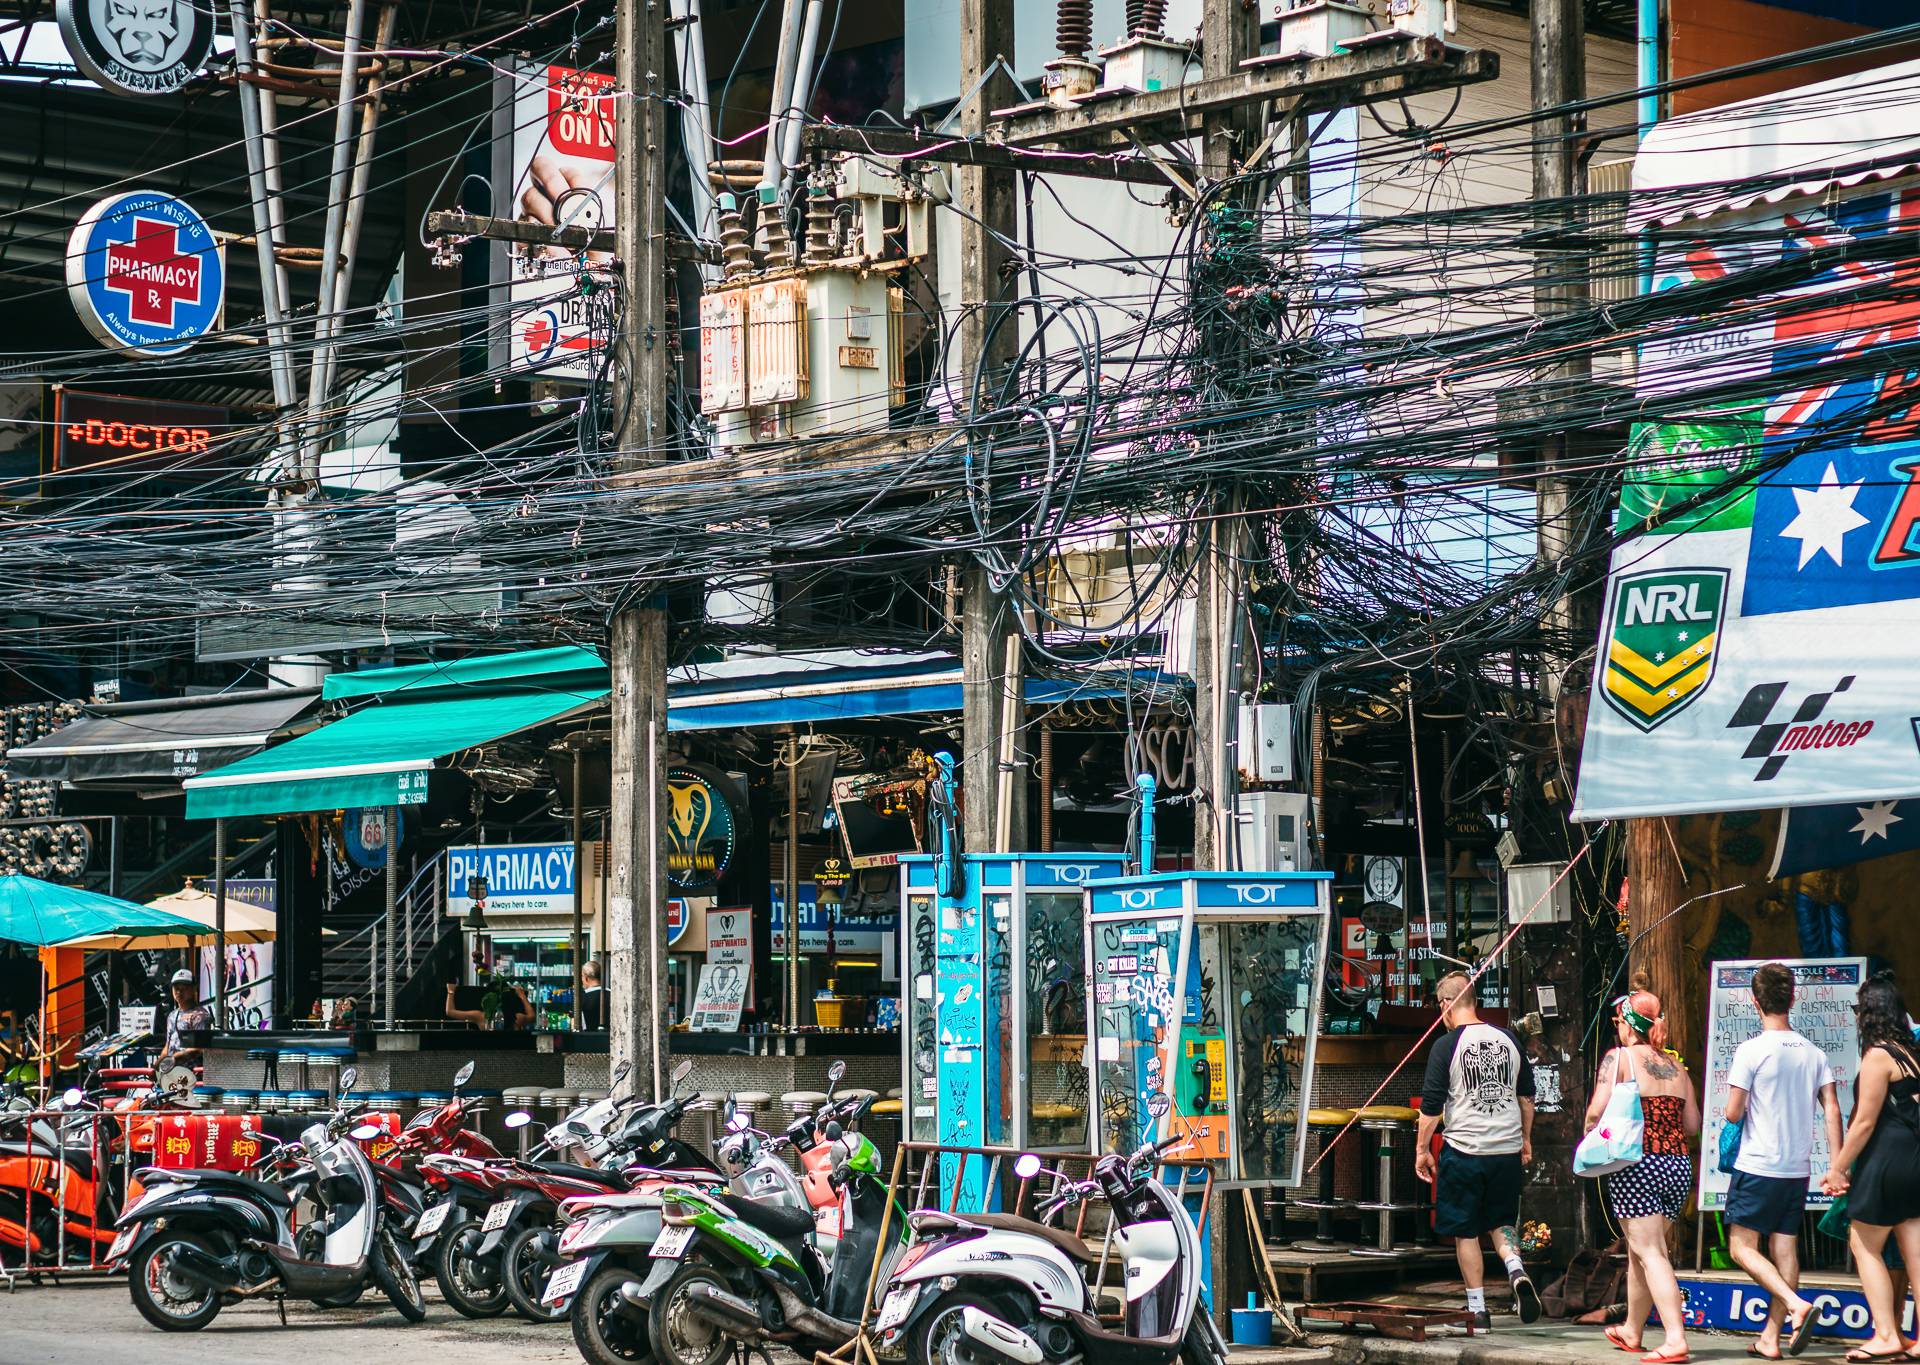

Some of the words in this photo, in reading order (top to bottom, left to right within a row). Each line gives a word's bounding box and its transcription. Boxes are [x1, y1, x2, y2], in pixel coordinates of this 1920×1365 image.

[104, 60, 192, 91] SURVIVE
[560, 114, 592, 145] ON
[109, 255, 198, 289] PHARMACY
[106, 311, 137, 342] Always
[1667, 330, 1751, 356] RACING
[1623, 582, 1713, 628] NRL
[364, 823, 382, 844] 66
[451, 850, 575, 893] PHARMACY
[695, 854, 715, 870] BAR
[1045, 864, 1099, 882] TOT
[1227, 883, 1286, 904] TOT
[491, 900, 511, 910] Always
[511, 900, 525, 909] here
[527, 901, 534, 909] to
[1112, 887, 1165, 909] TOT
[725, 938, 748, 948] WANTED
[1815, 985, 1834, 1000] AM
[1802, 1000, 1852, 1014] AUSTRALIA
[655, 1245, 678, 1256] 264
[1729, 1289, 1791, 1323] Ic
